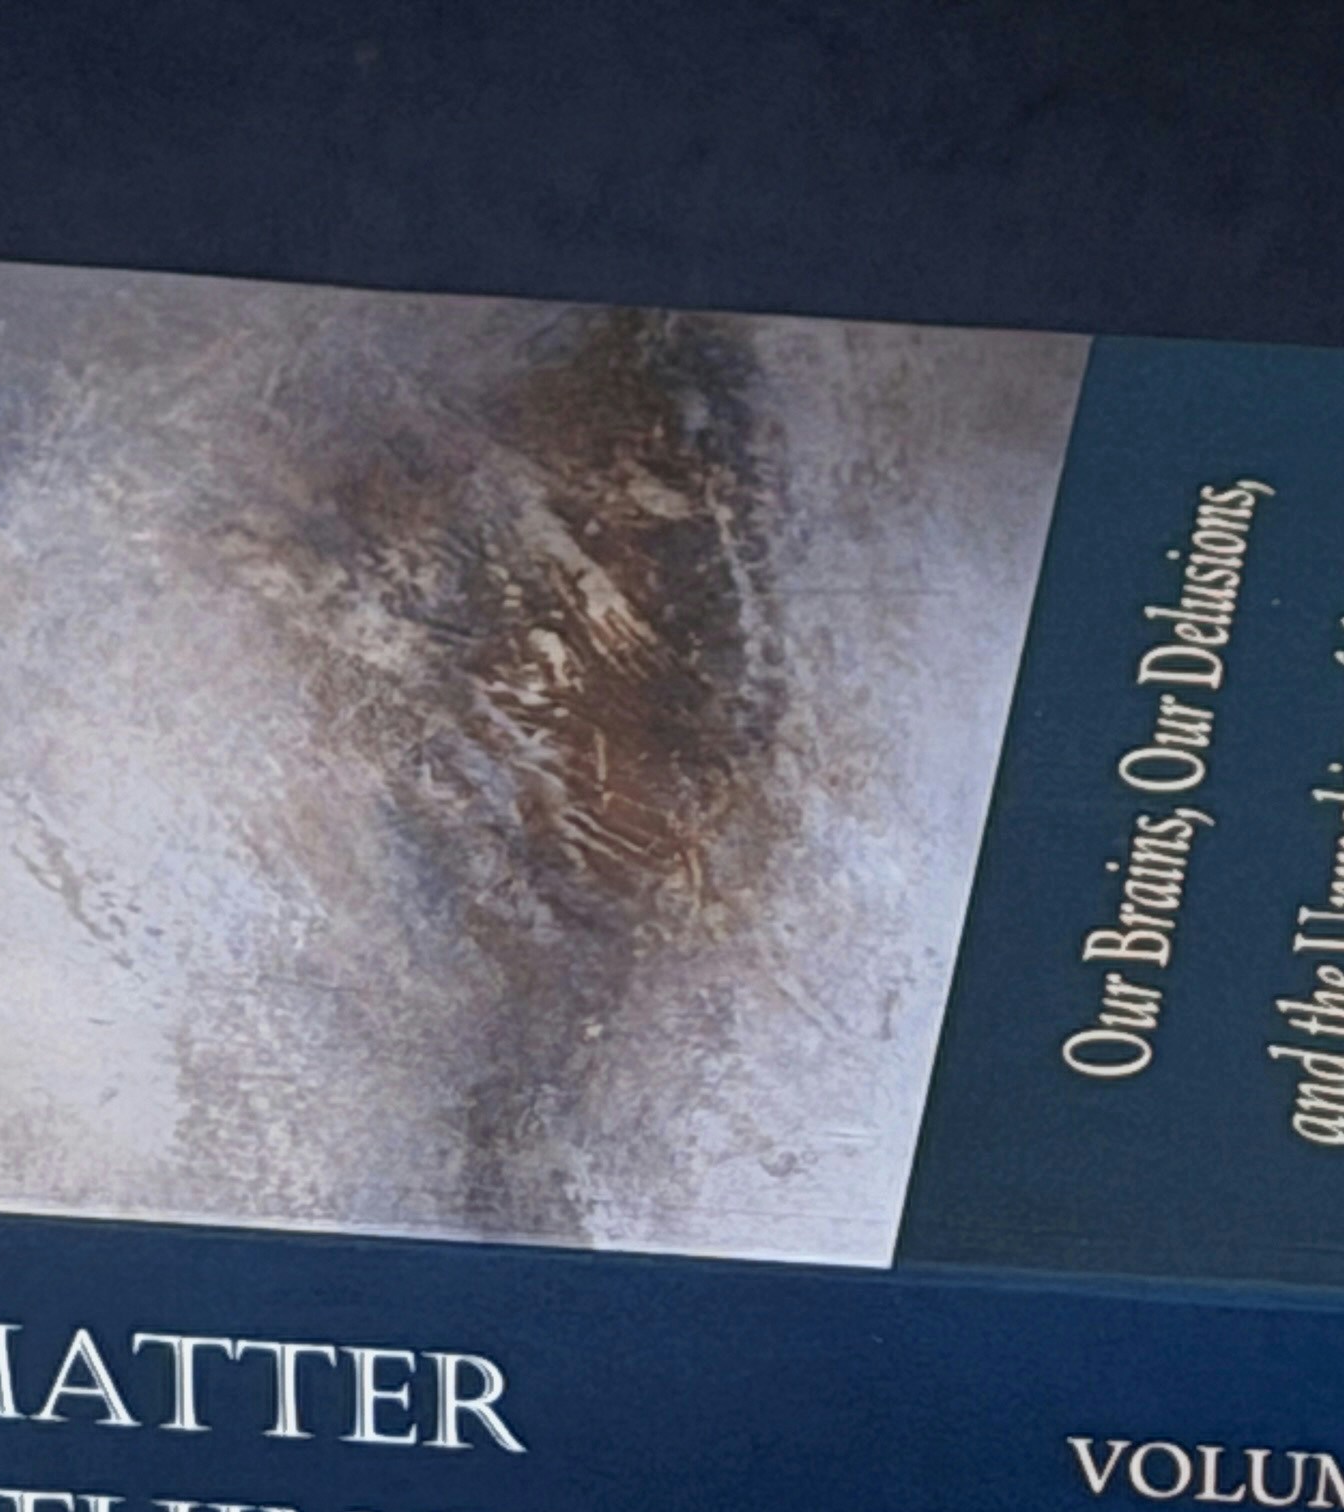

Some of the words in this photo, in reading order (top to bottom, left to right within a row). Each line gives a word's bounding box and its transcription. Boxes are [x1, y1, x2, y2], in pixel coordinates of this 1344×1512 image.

[1137, 480, 1275, 689] Delusions,
[1118, 694, 1214, 791] Our
[1082, 808, 1214, 967] Brains,
[1062, 973, 1162, 1077] Our
